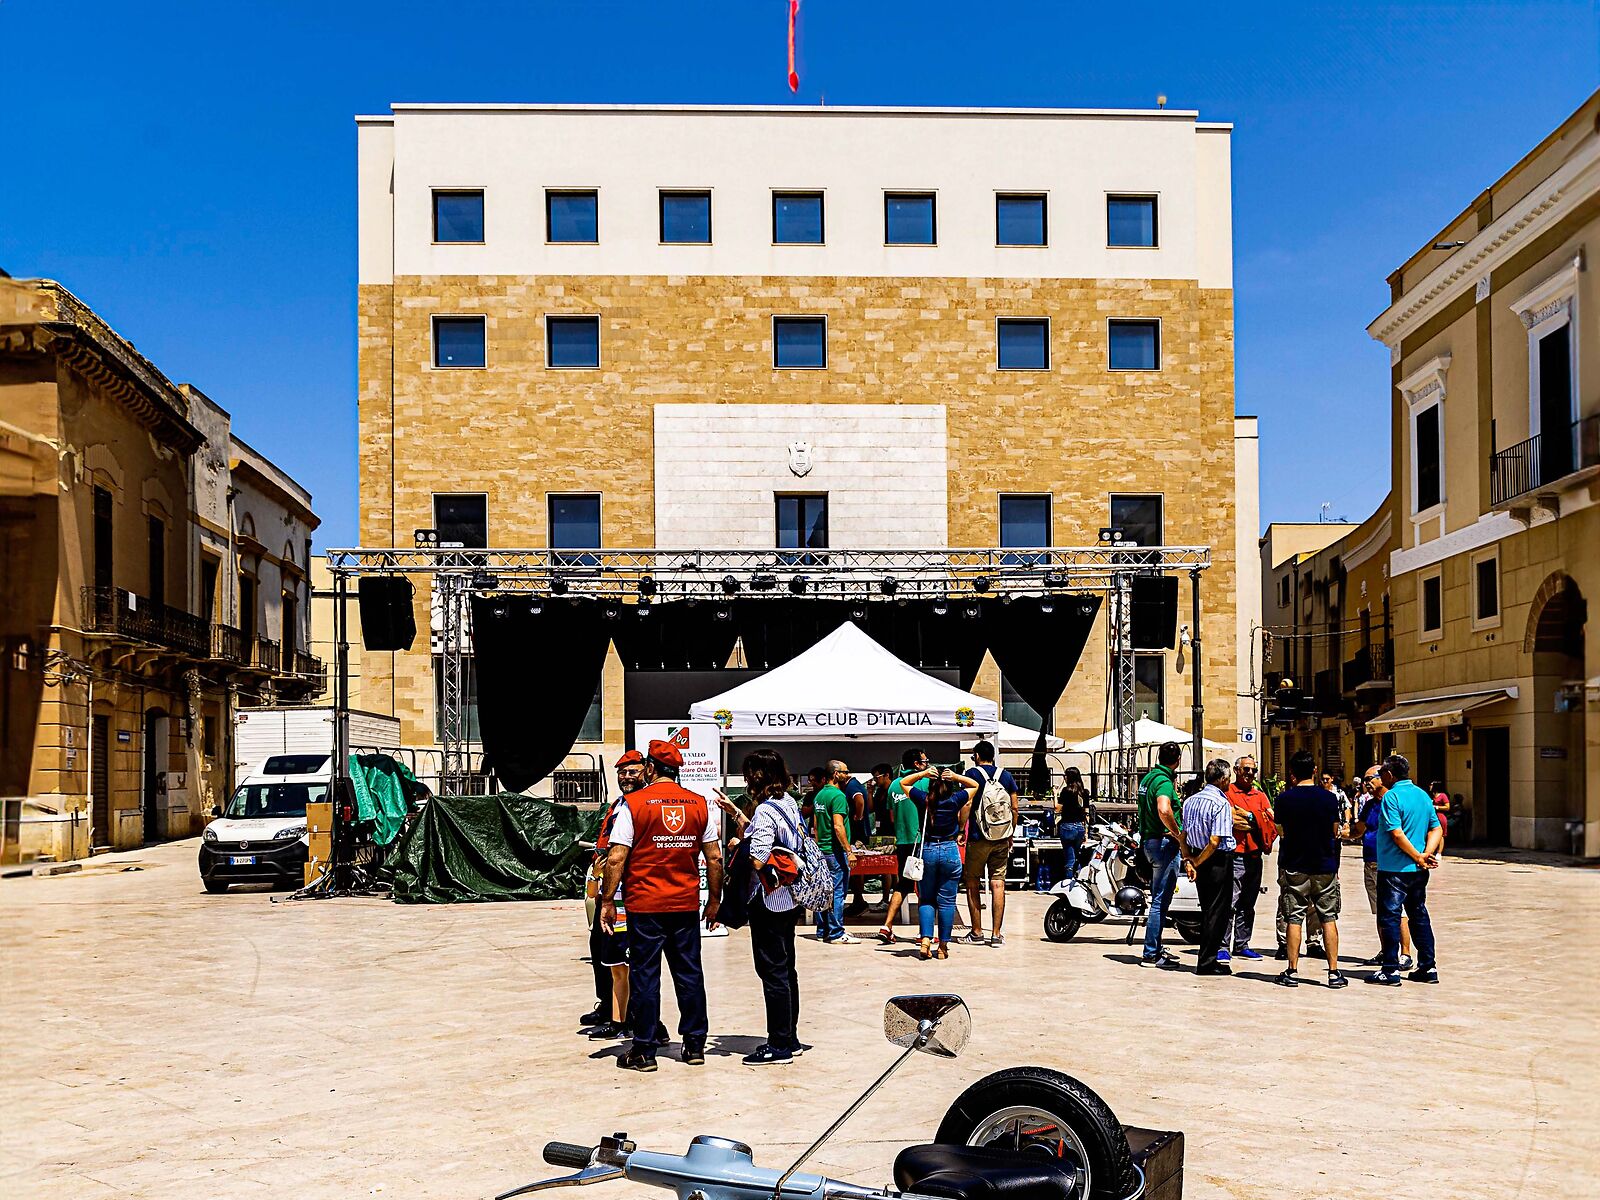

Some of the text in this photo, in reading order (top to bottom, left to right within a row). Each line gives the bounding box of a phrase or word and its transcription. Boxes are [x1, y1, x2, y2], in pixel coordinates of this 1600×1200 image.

[755, 712, 932, 726] VESPA CLUB D'ITALIA
